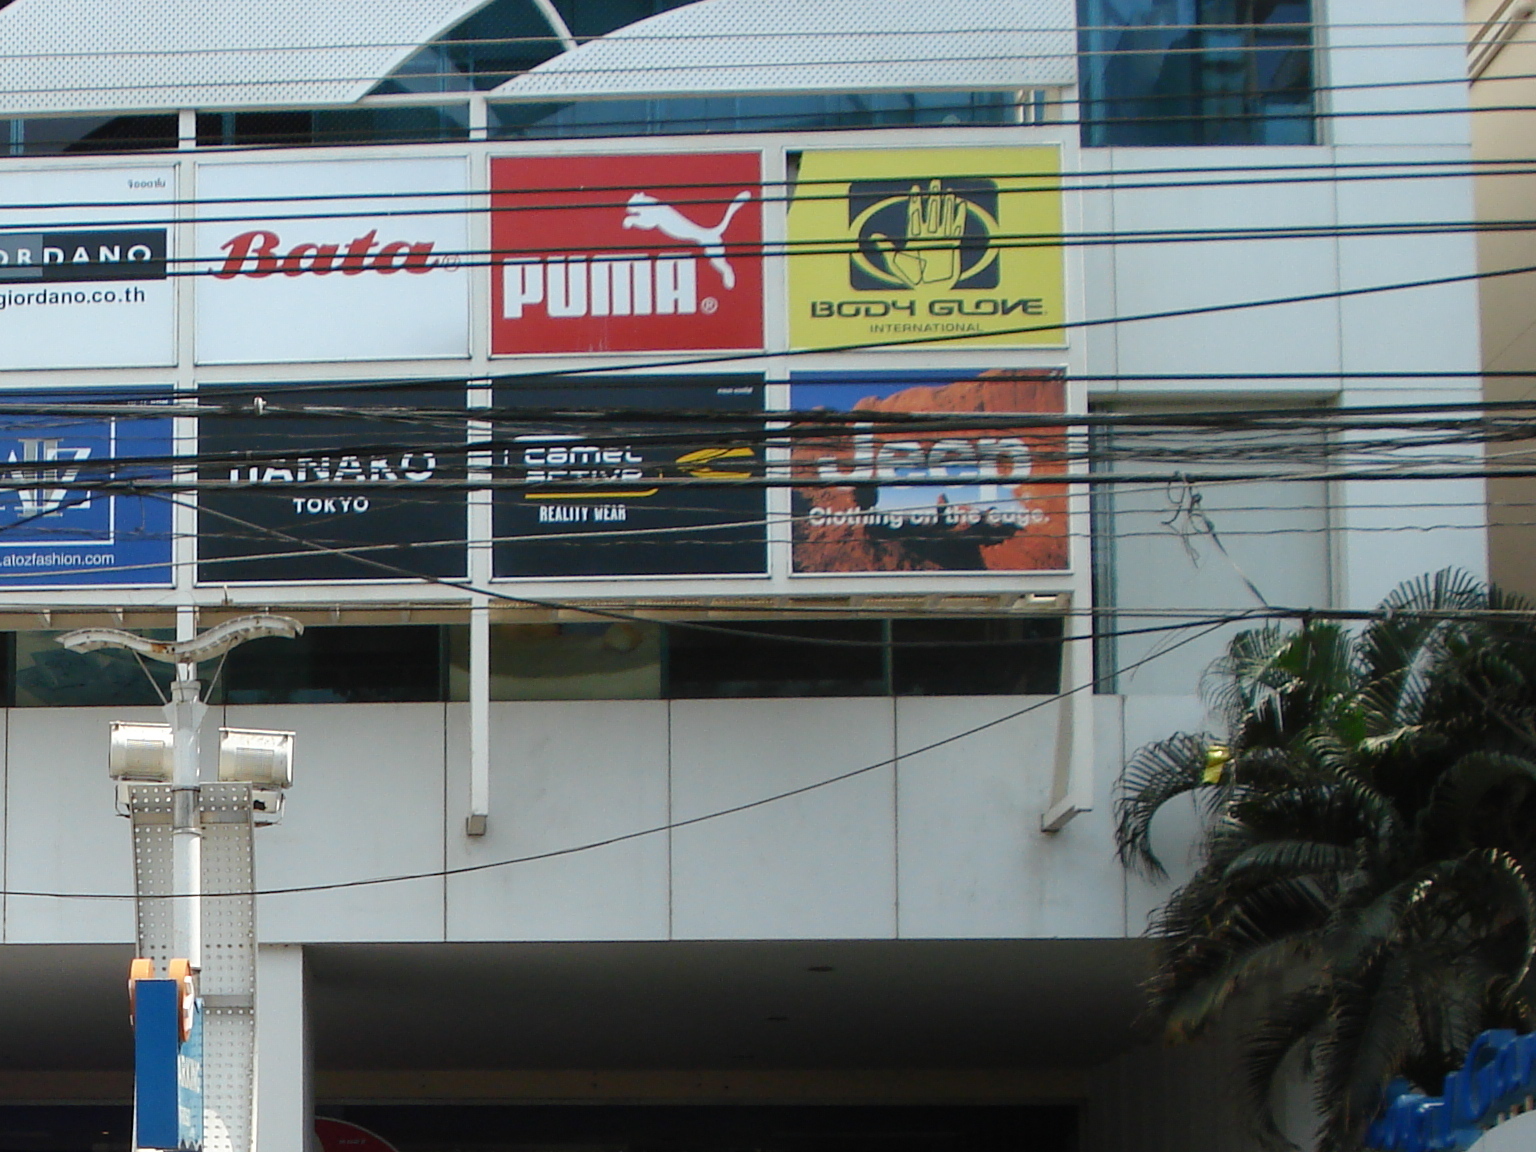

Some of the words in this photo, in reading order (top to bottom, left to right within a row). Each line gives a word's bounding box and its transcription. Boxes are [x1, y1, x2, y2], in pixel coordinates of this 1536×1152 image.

[208, 229, 442, 280] Bata
[503, 252, 698, 320] PUMA
[810, 299, 916, 318] BODY
[928, 297, 1045, 317] GLOVE
[869, 322, 984, 334] INTERNATIONAL
[292, 496, 370, 515] TOKYO
[538, 505, 589, 523] REALITY
[594, 504, 627, 522] WEAR
[809, 507, 904, 528] Clothing
[910, 508, 939, 526] on
[945, 506, 982, 526] the
